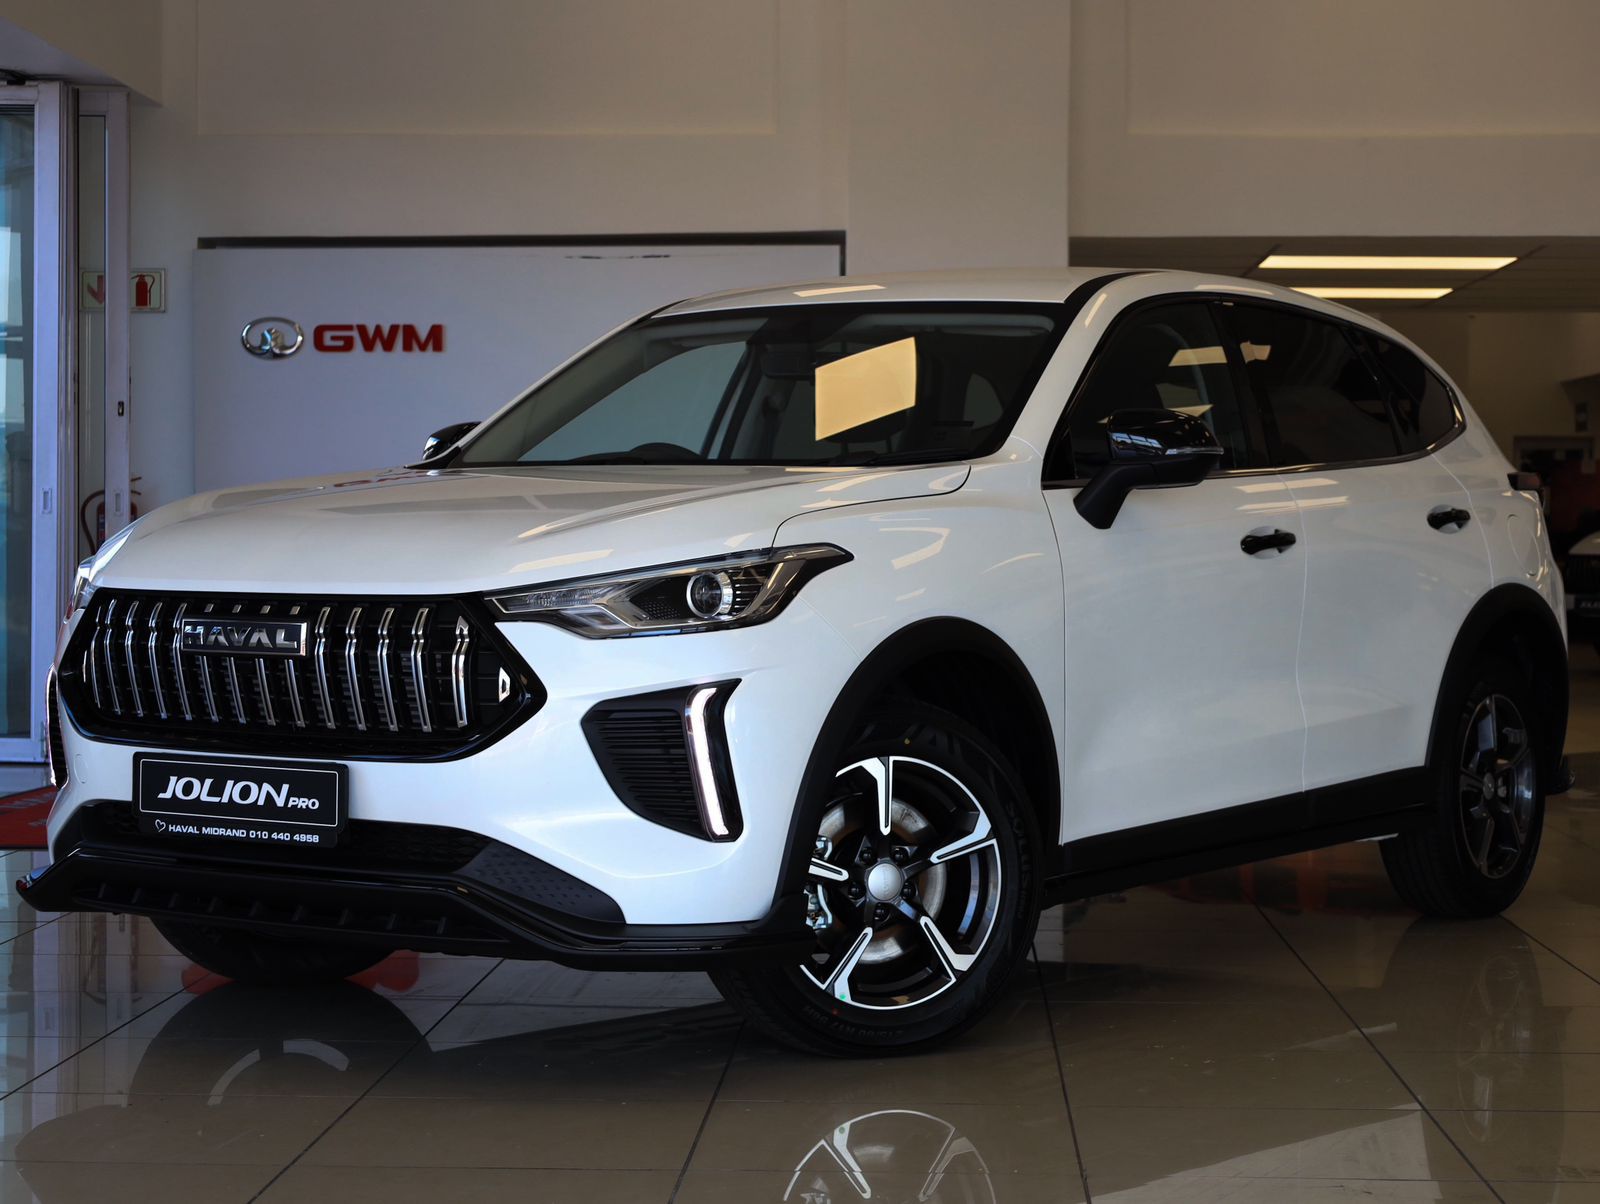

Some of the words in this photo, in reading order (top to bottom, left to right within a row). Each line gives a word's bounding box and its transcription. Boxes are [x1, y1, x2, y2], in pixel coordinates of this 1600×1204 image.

[313, 324, 444, 353] GWM
[184, 625, 298, 649] HAVAL
[157, 775, 290, 808] JOLION
[287, 796, 320, 810] PRO
[168, 823, 200, 835] HAVAL
[202, 826, 247, 838] MIDRAND
[249, 830, 269, 840] 010
[271, 832, 291, 842] 440
[293, 833, 320, 843] 4958
